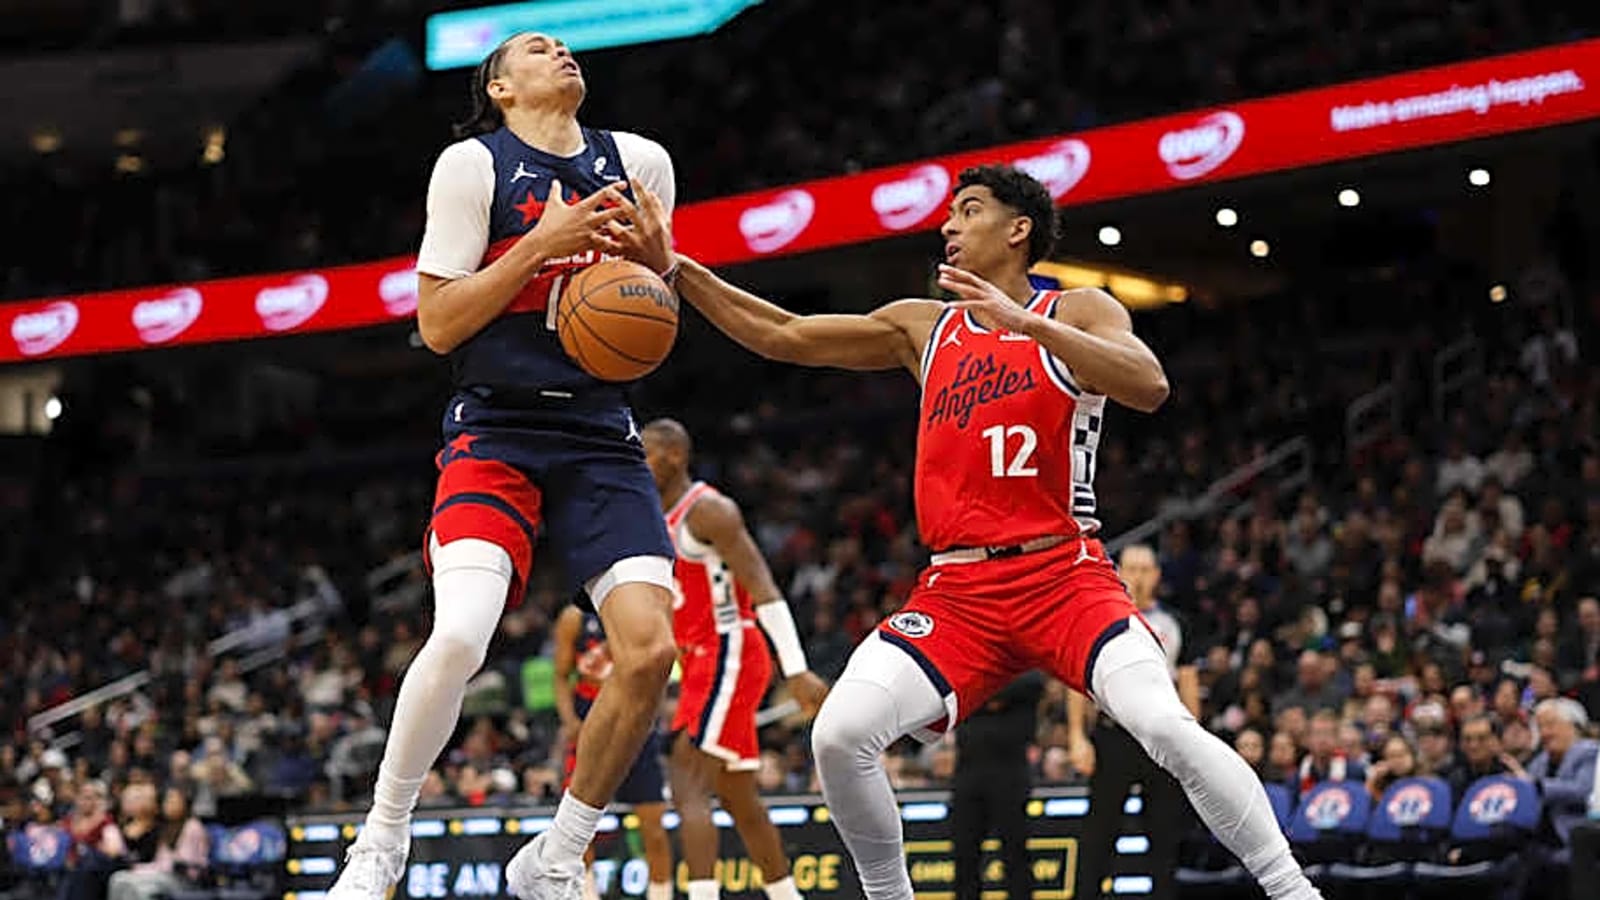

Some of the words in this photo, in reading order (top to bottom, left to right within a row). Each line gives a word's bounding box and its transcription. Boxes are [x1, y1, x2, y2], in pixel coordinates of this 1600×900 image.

[951, 352, 998, 390] Los
[927, 363, 1037, 430] Angeles
[981, 424, 1039, 478] 12
[407, 862, 449, 899] BE
